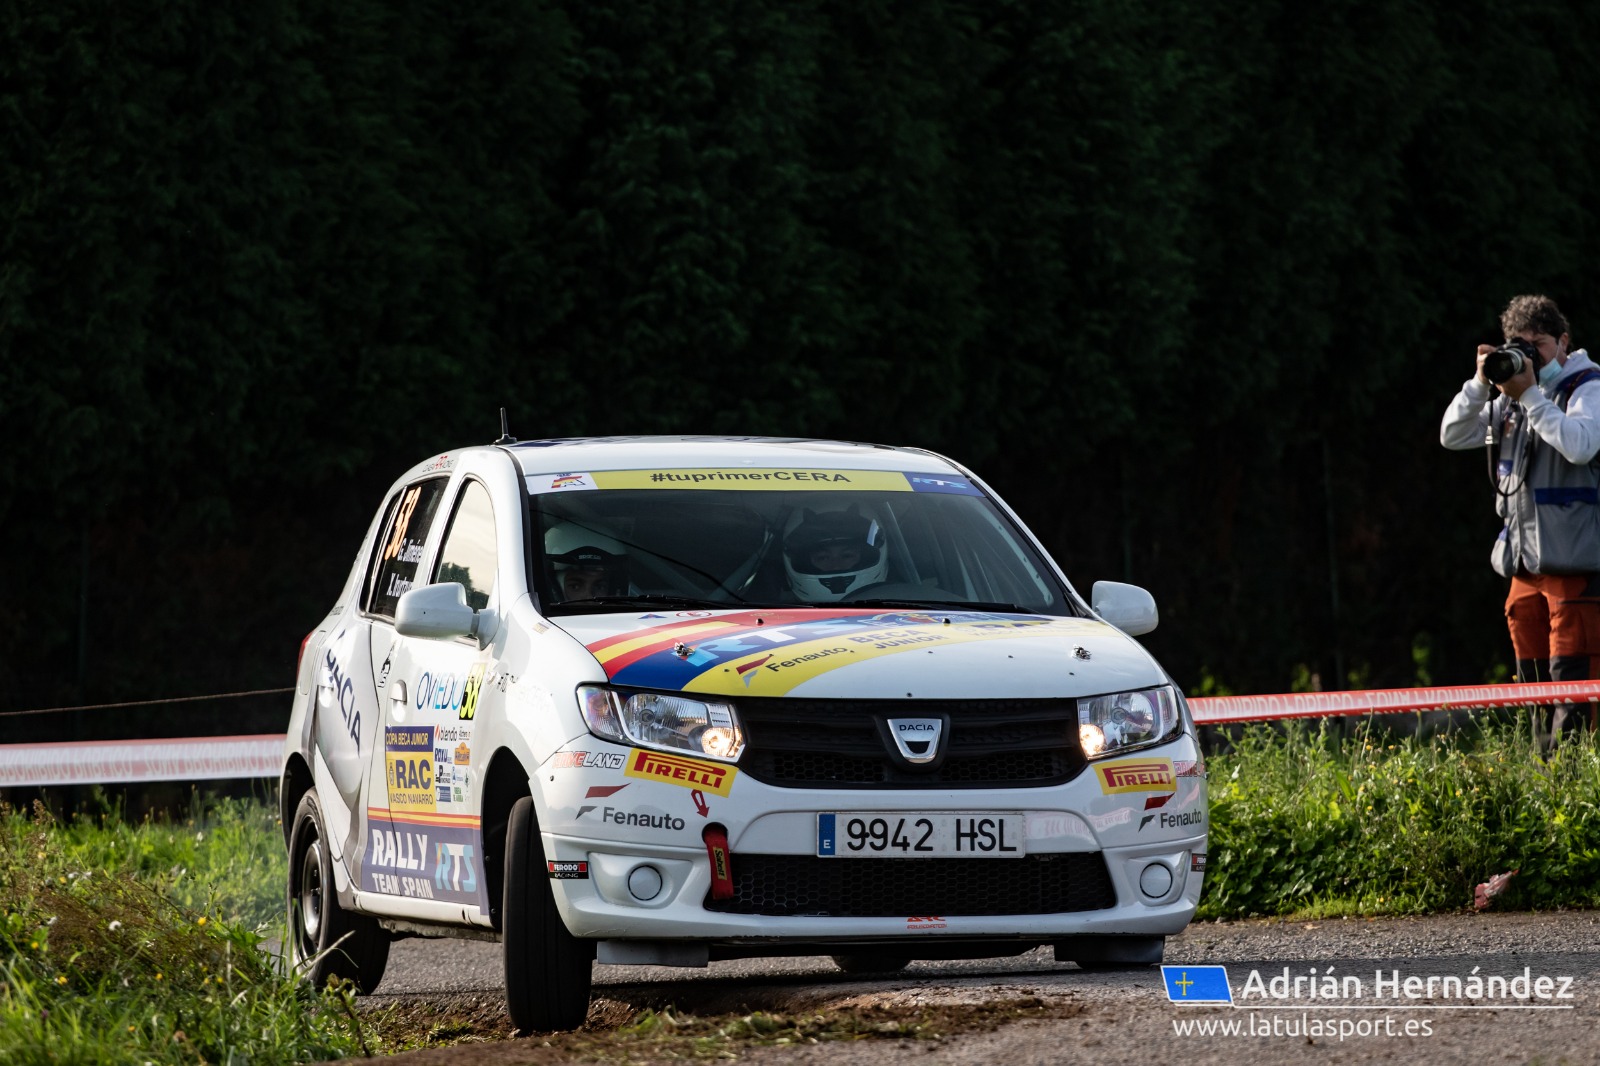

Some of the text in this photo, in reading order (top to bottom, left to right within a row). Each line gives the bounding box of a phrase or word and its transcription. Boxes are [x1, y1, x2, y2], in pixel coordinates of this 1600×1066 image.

[650, 471, 852, 483] #tuprimerCERA
[848, 628, 930, 643] BECA
[874, 633, 948, 649] JUNIOR
[386, 733, 429, 746] COPA BECA JUNIOR
[395, 759, 432, 790] RAC
[633, 751, 727, 788] PIRELLI
[1102, 763, 1172, 788] PIRELLI
[390, 793, 407, 804] VASCO
[408, 793, 434, 805] NAVARRO
[602, 806, 686, 831] Fenauto
[1160, 808, 1202, 829] Fenauto
[823, 818, 1017, 852] E 9942 HSL
[371, 828, 428, 871] RALLY
[434, 841, 477, 893] RTS
[371, 872, 434, 899] TEAM SPAIN
